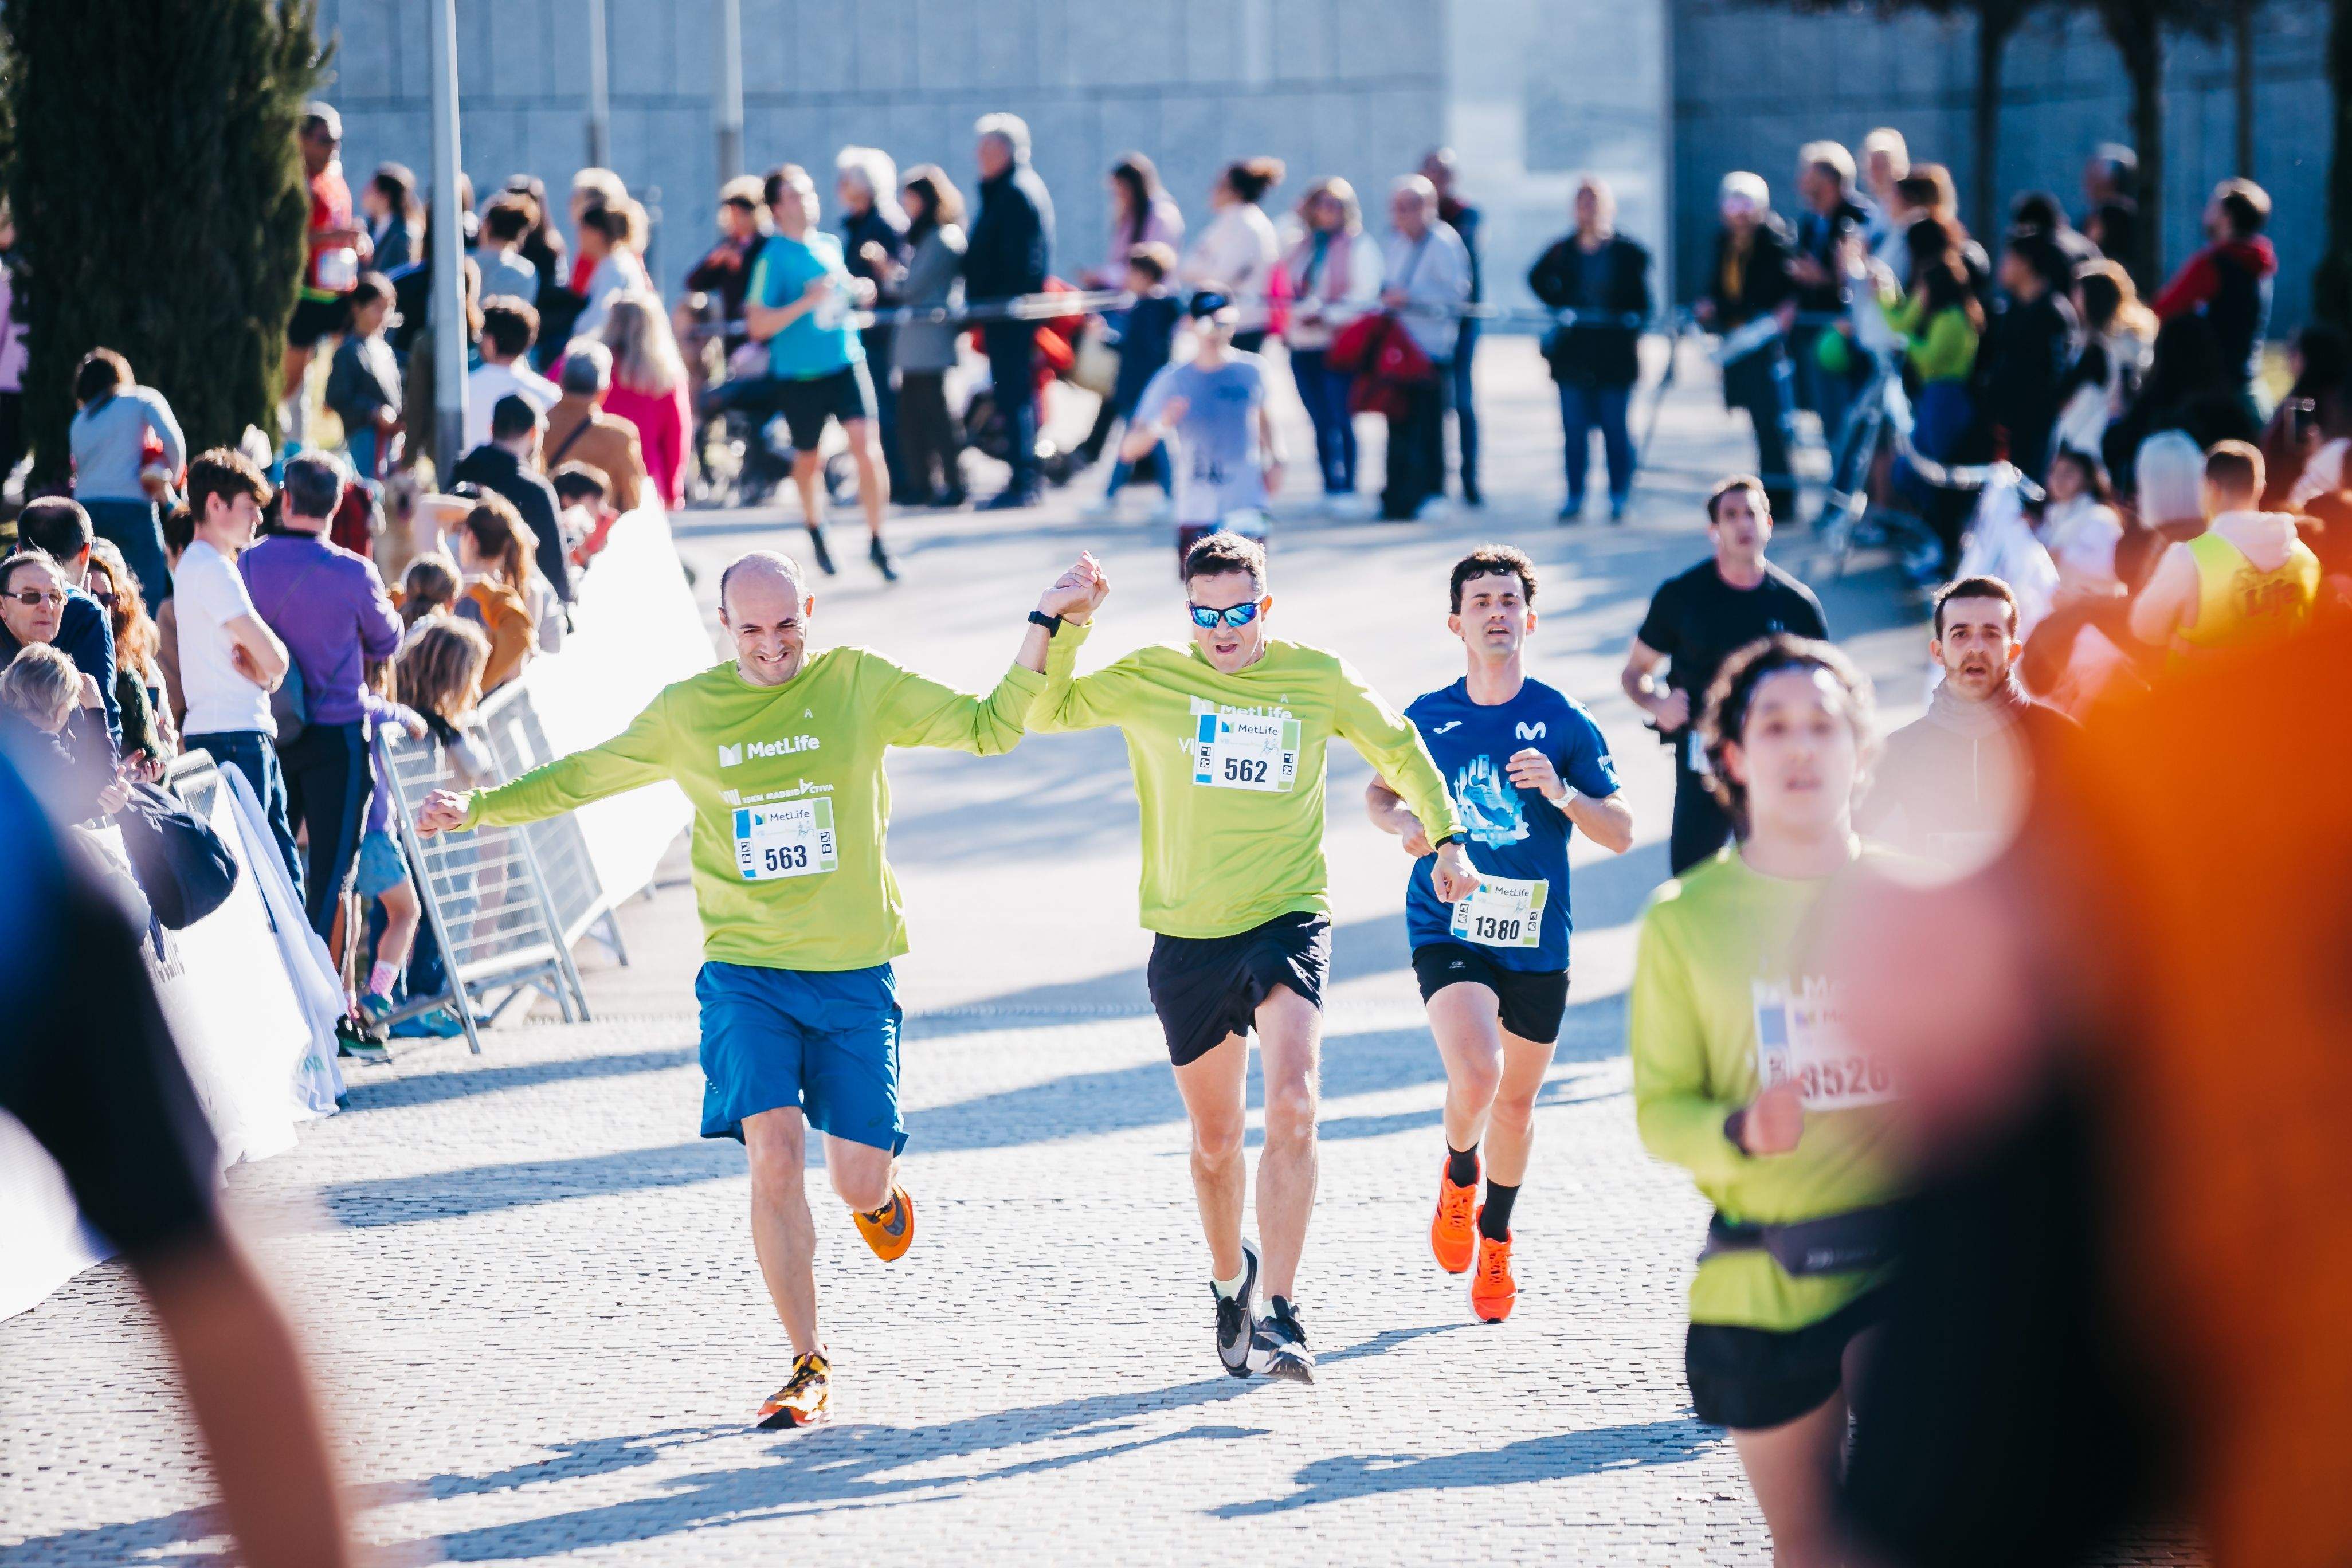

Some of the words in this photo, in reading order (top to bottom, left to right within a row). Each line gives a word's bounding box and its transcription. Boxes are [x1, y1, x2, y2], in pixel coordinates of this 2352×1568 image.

[1238, 724, 1278, 735] MetLife
[747, 734, 820, 759] MetLife
[1225, 758, 1268, 783] 562
[770, 809, 810, 822] MetLife
[765, 845, 807, 871] 563
[1495, 886, 1530, 897] MetLife
[1476, 916, 1520, 940] 1380
